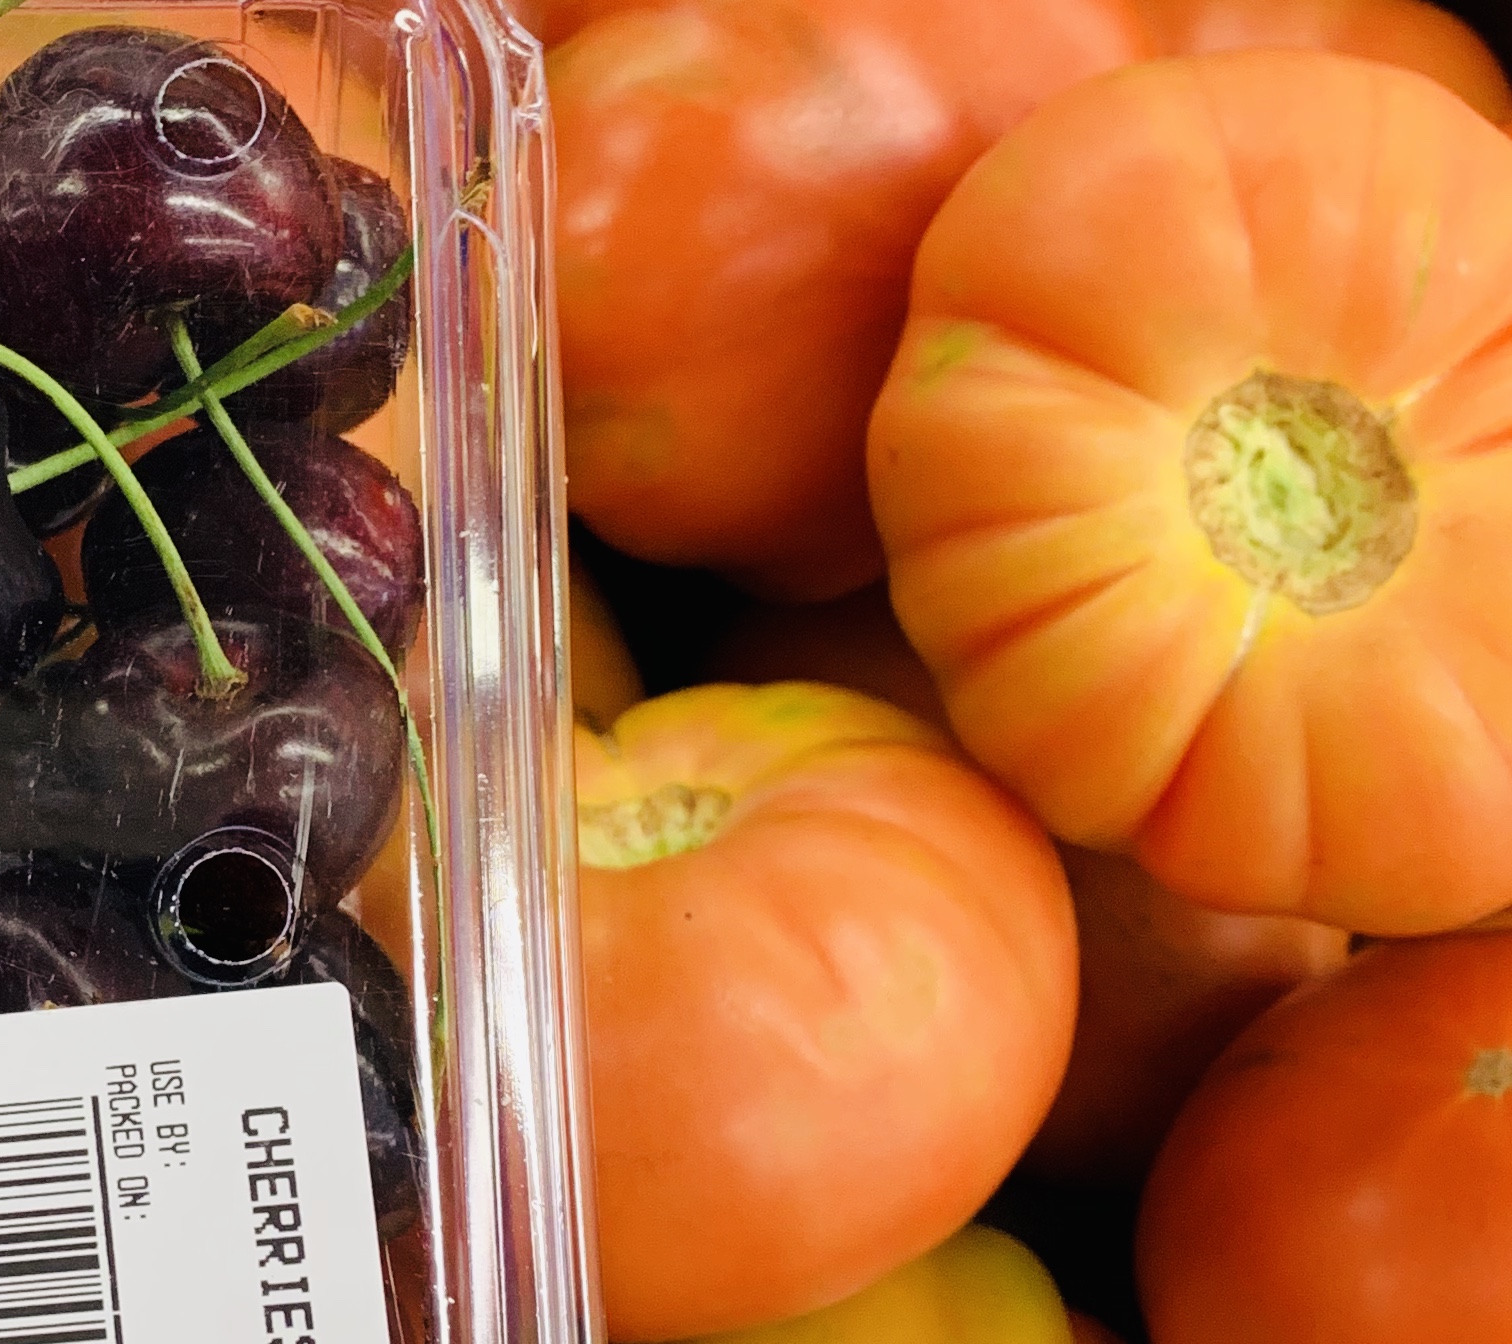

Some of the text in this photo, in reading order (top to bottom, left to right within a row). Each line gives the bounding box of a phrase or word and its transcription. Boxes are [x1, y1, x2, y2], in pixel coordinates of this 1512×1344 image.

[103, 1064, 150, 1220] PACKED ON:
[150, 1059, 190, 1167] USE BY:
